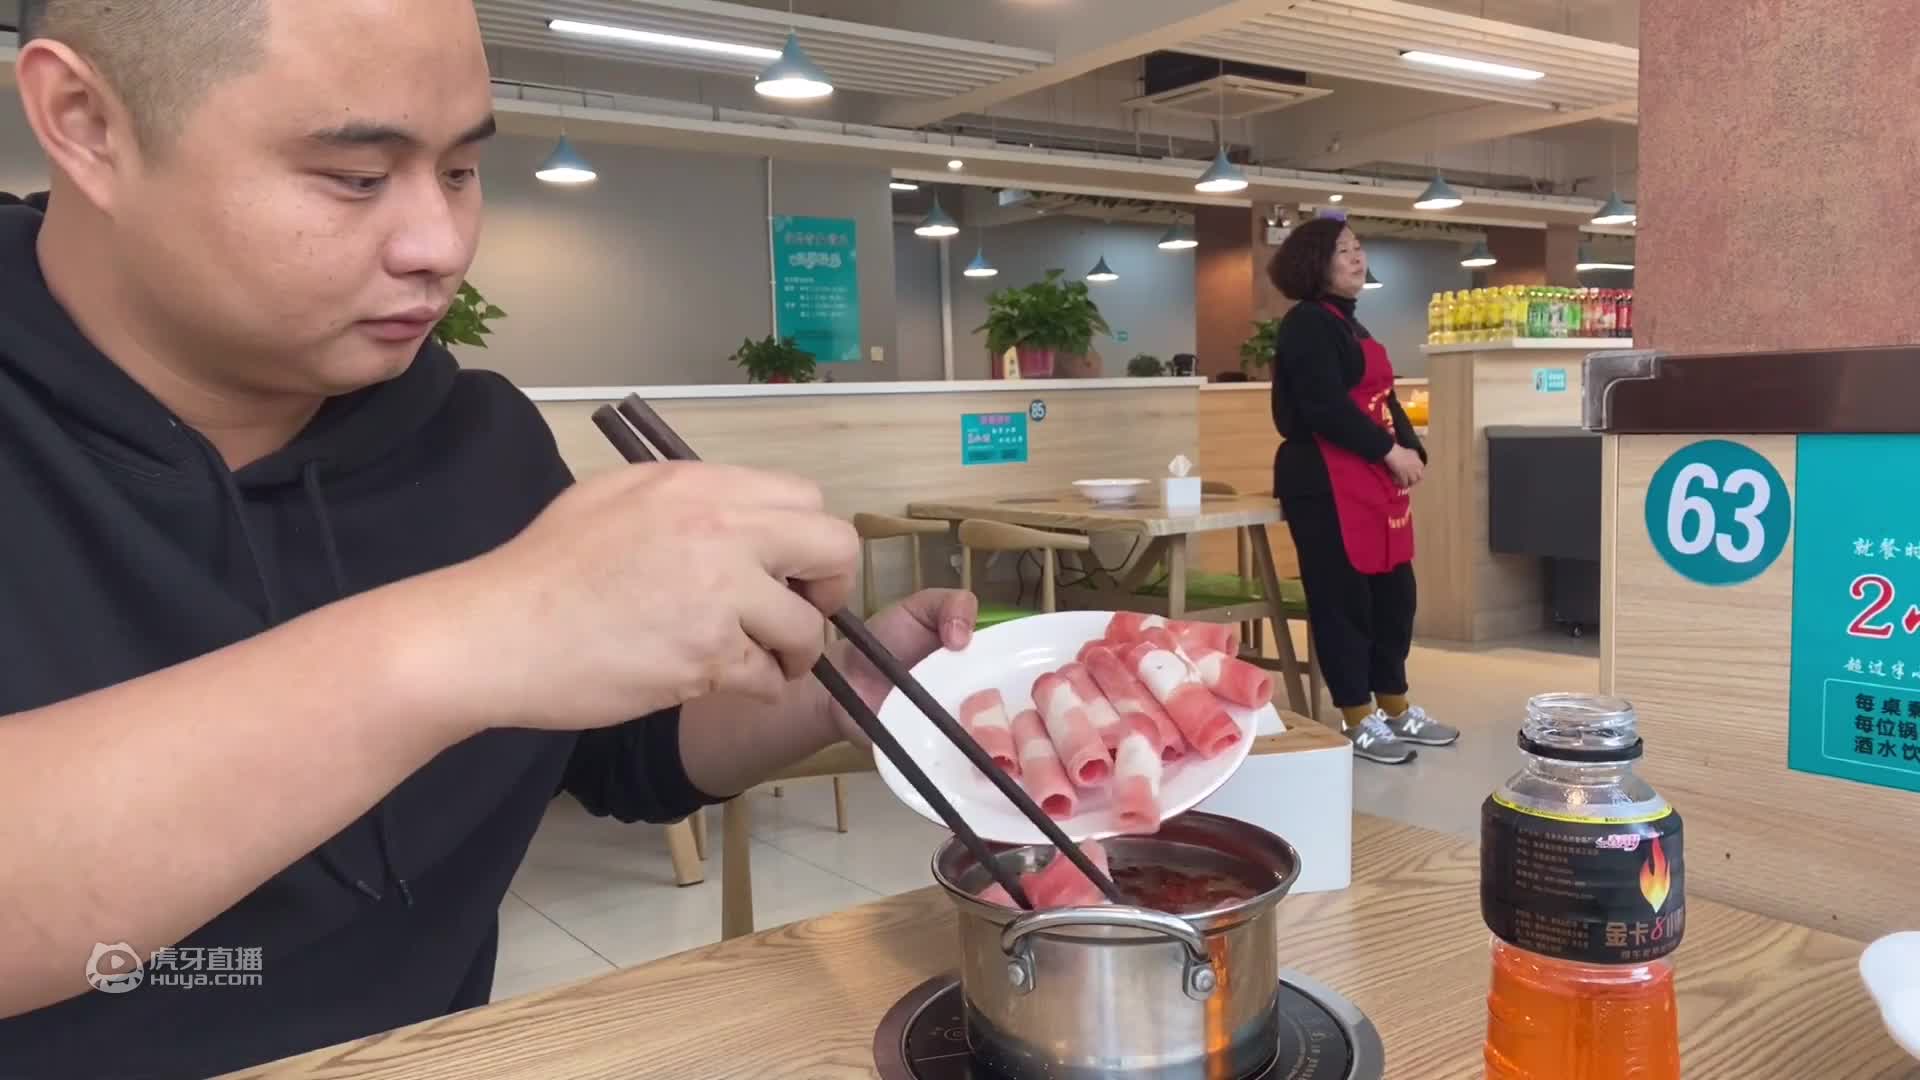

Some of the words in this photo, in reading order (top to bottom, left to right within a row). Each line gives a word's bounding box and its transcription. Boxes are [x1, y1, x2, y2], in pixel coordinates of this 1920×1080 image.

[1667, 462, 1771, 564] 63
[1855, 714, 1918, 741] 每位锅
